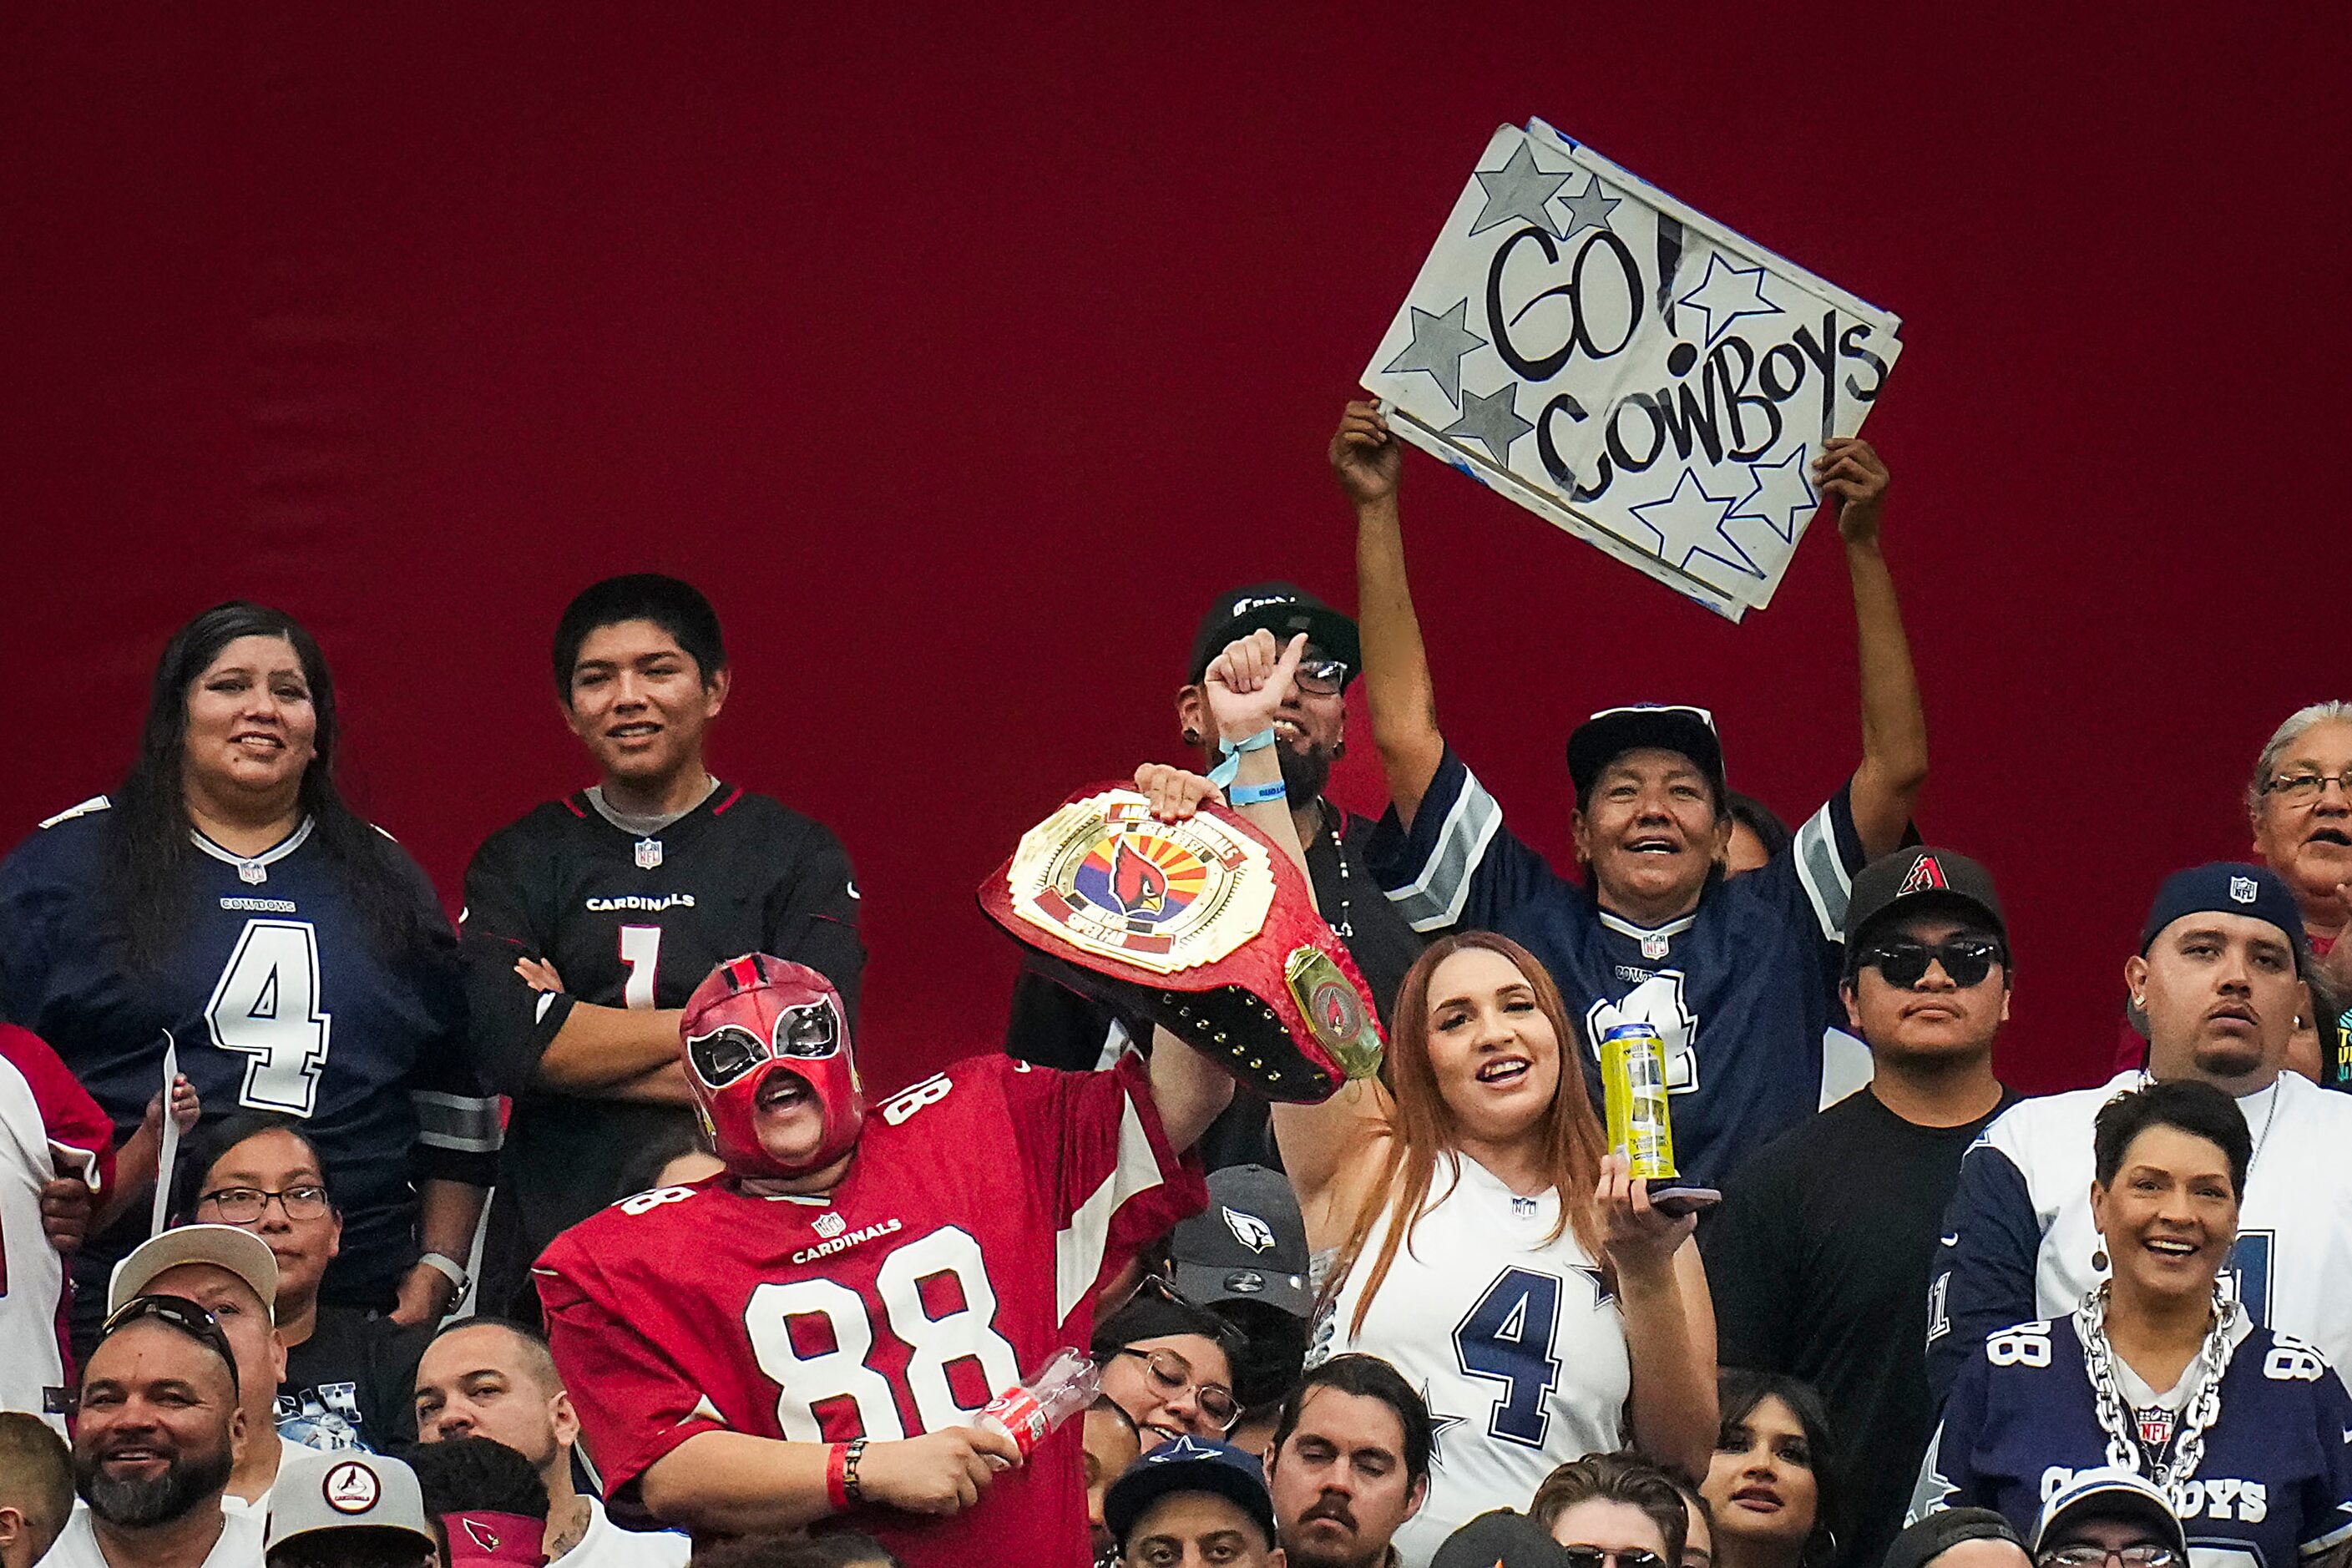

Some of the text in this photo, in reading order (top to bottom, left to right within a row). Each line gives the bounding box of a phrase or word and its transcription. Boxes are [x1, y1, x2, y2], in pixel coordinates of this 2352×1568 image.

[1536, 311, 1888, 503] COWBOYS
[586, 893, 695, 911] CARDINALS
[2234, 888, 2253, 899] NFL
[619, 924, 662, 1010] 1
[205, 918, 331, 1117] 4
[610, 1186, 697, 1216] 8
[792, 1218, 902, 1264] CARDINALS
[743, 1225, 1021, 1444] 88
[1451, 1264, 1562, 1450] 4
[2141, 1422, 2171, 1442] NFL
